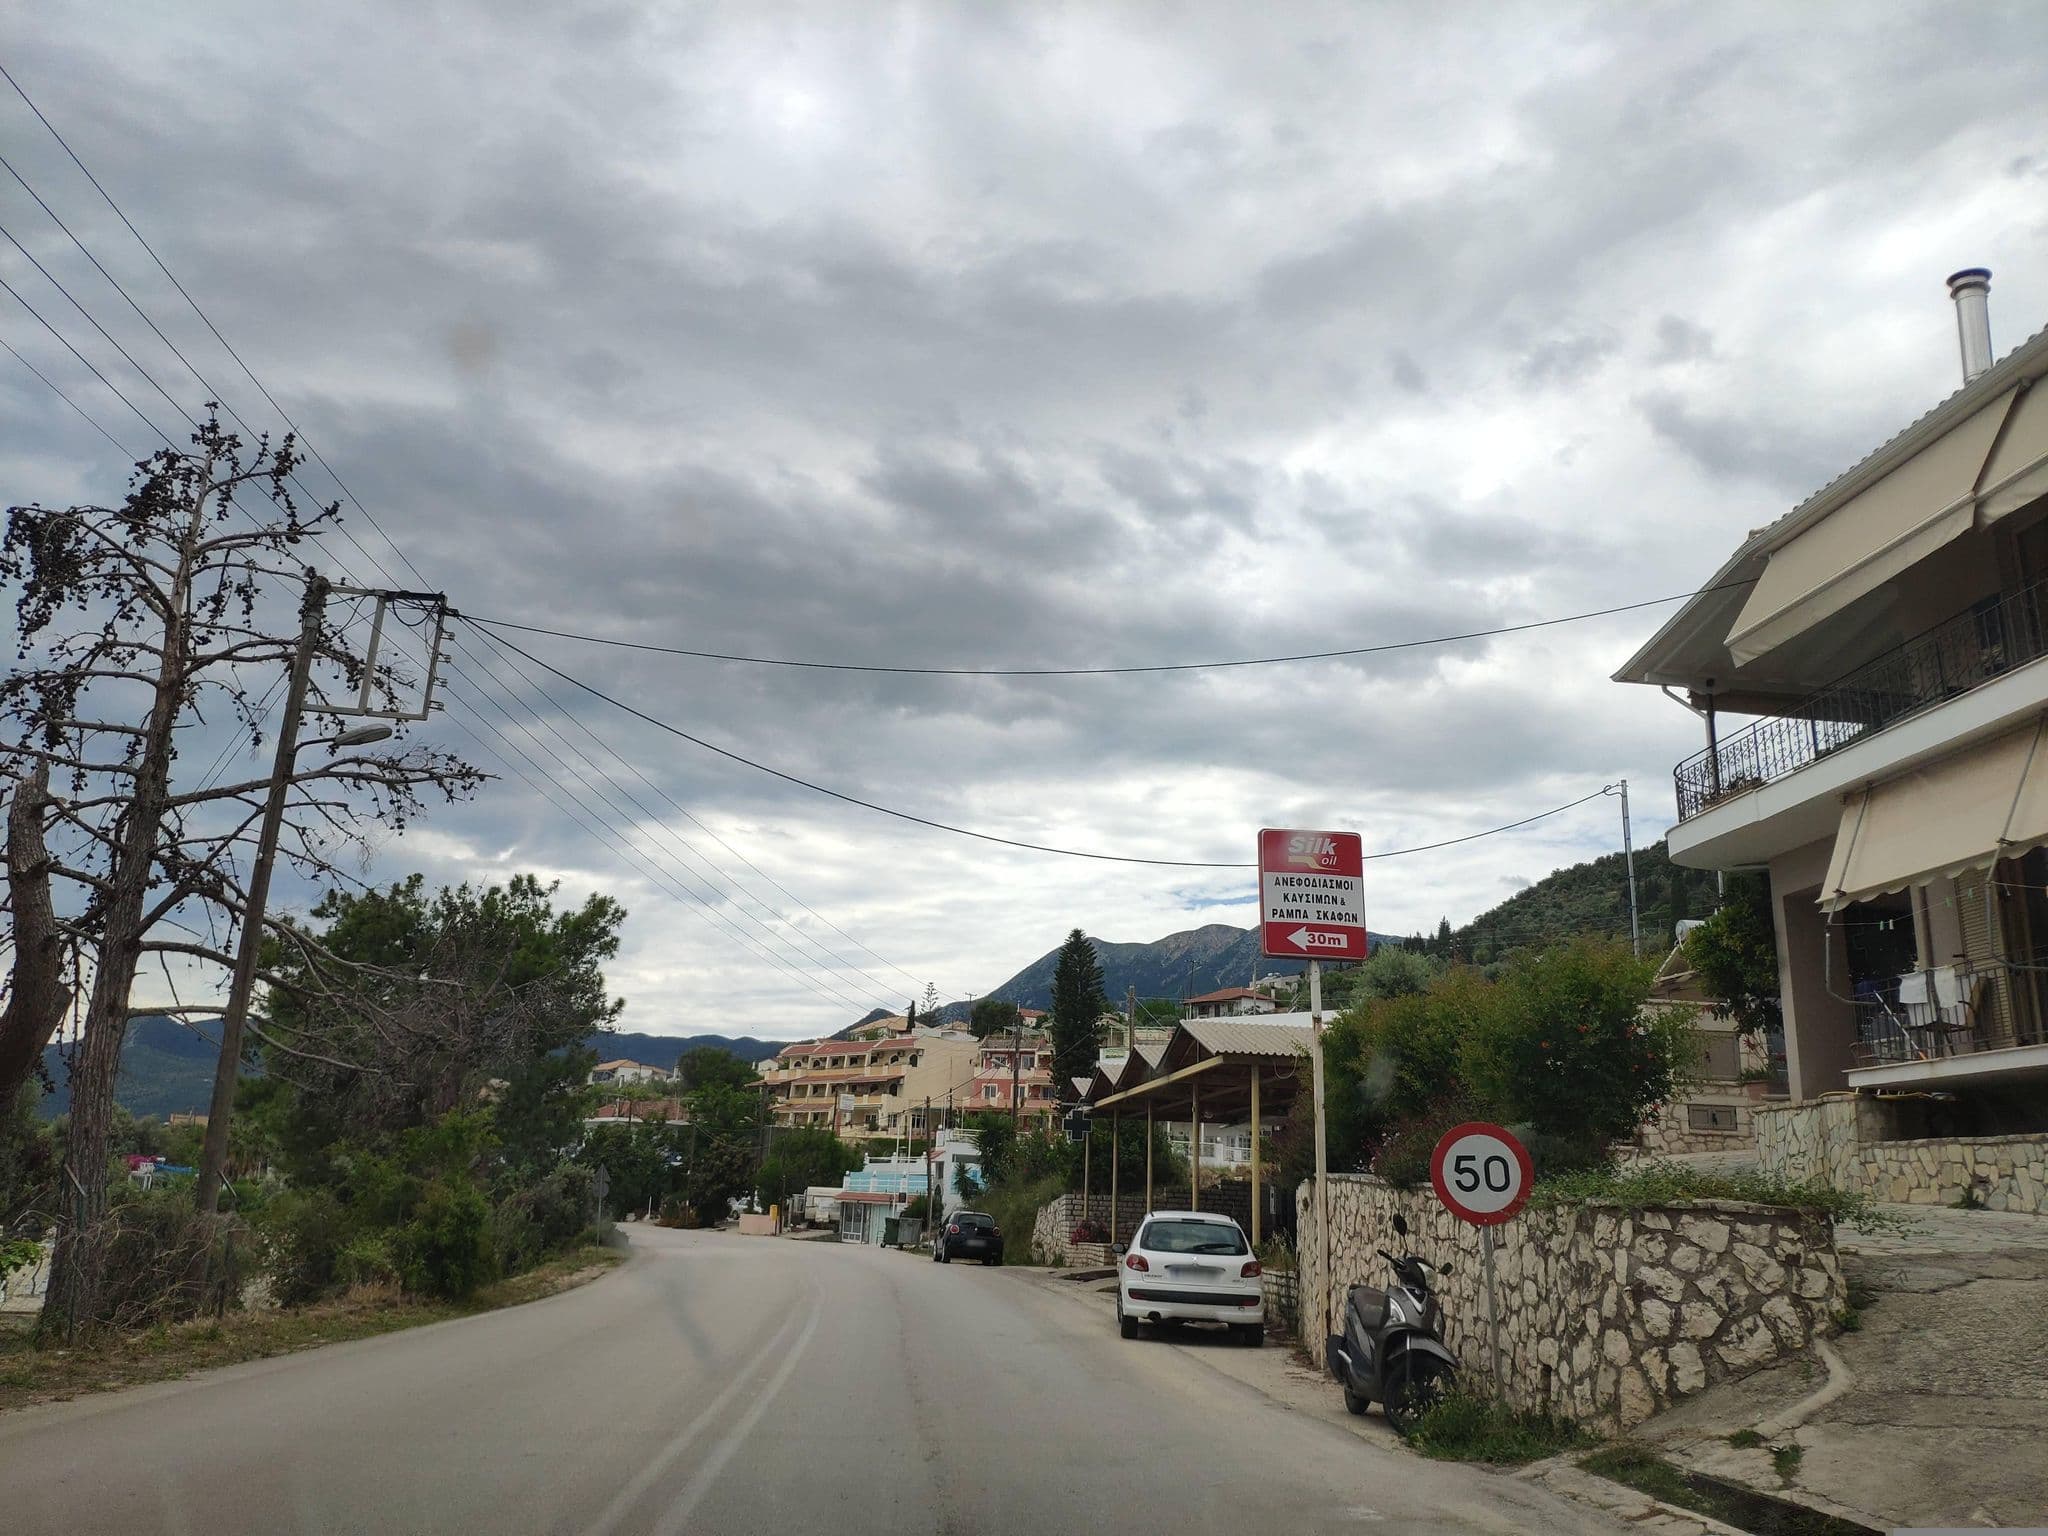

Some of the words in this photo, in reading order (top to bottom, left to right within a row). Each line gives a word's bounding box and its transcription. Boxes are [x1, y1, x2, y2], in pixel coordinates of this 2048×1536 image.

[1321, 855, 1337, 865] oil
[1274, 876, 1353, 891] ΑΝΕΦΟΔΙΑΣΜΟΙ
[1283, 893, 1338, 906] ΚΑΥΣΙΜΩΝ
[1340, 897, 1346, 906] &
[1272, 909, 1308, 921] ΡΑΜΠΑ
[1316, 910, 1358, 923] ΣΚΑΦΩΝ
[1307, 934, 1341, 945] 30m
[1454, 1155, 1510, 1193] 50
